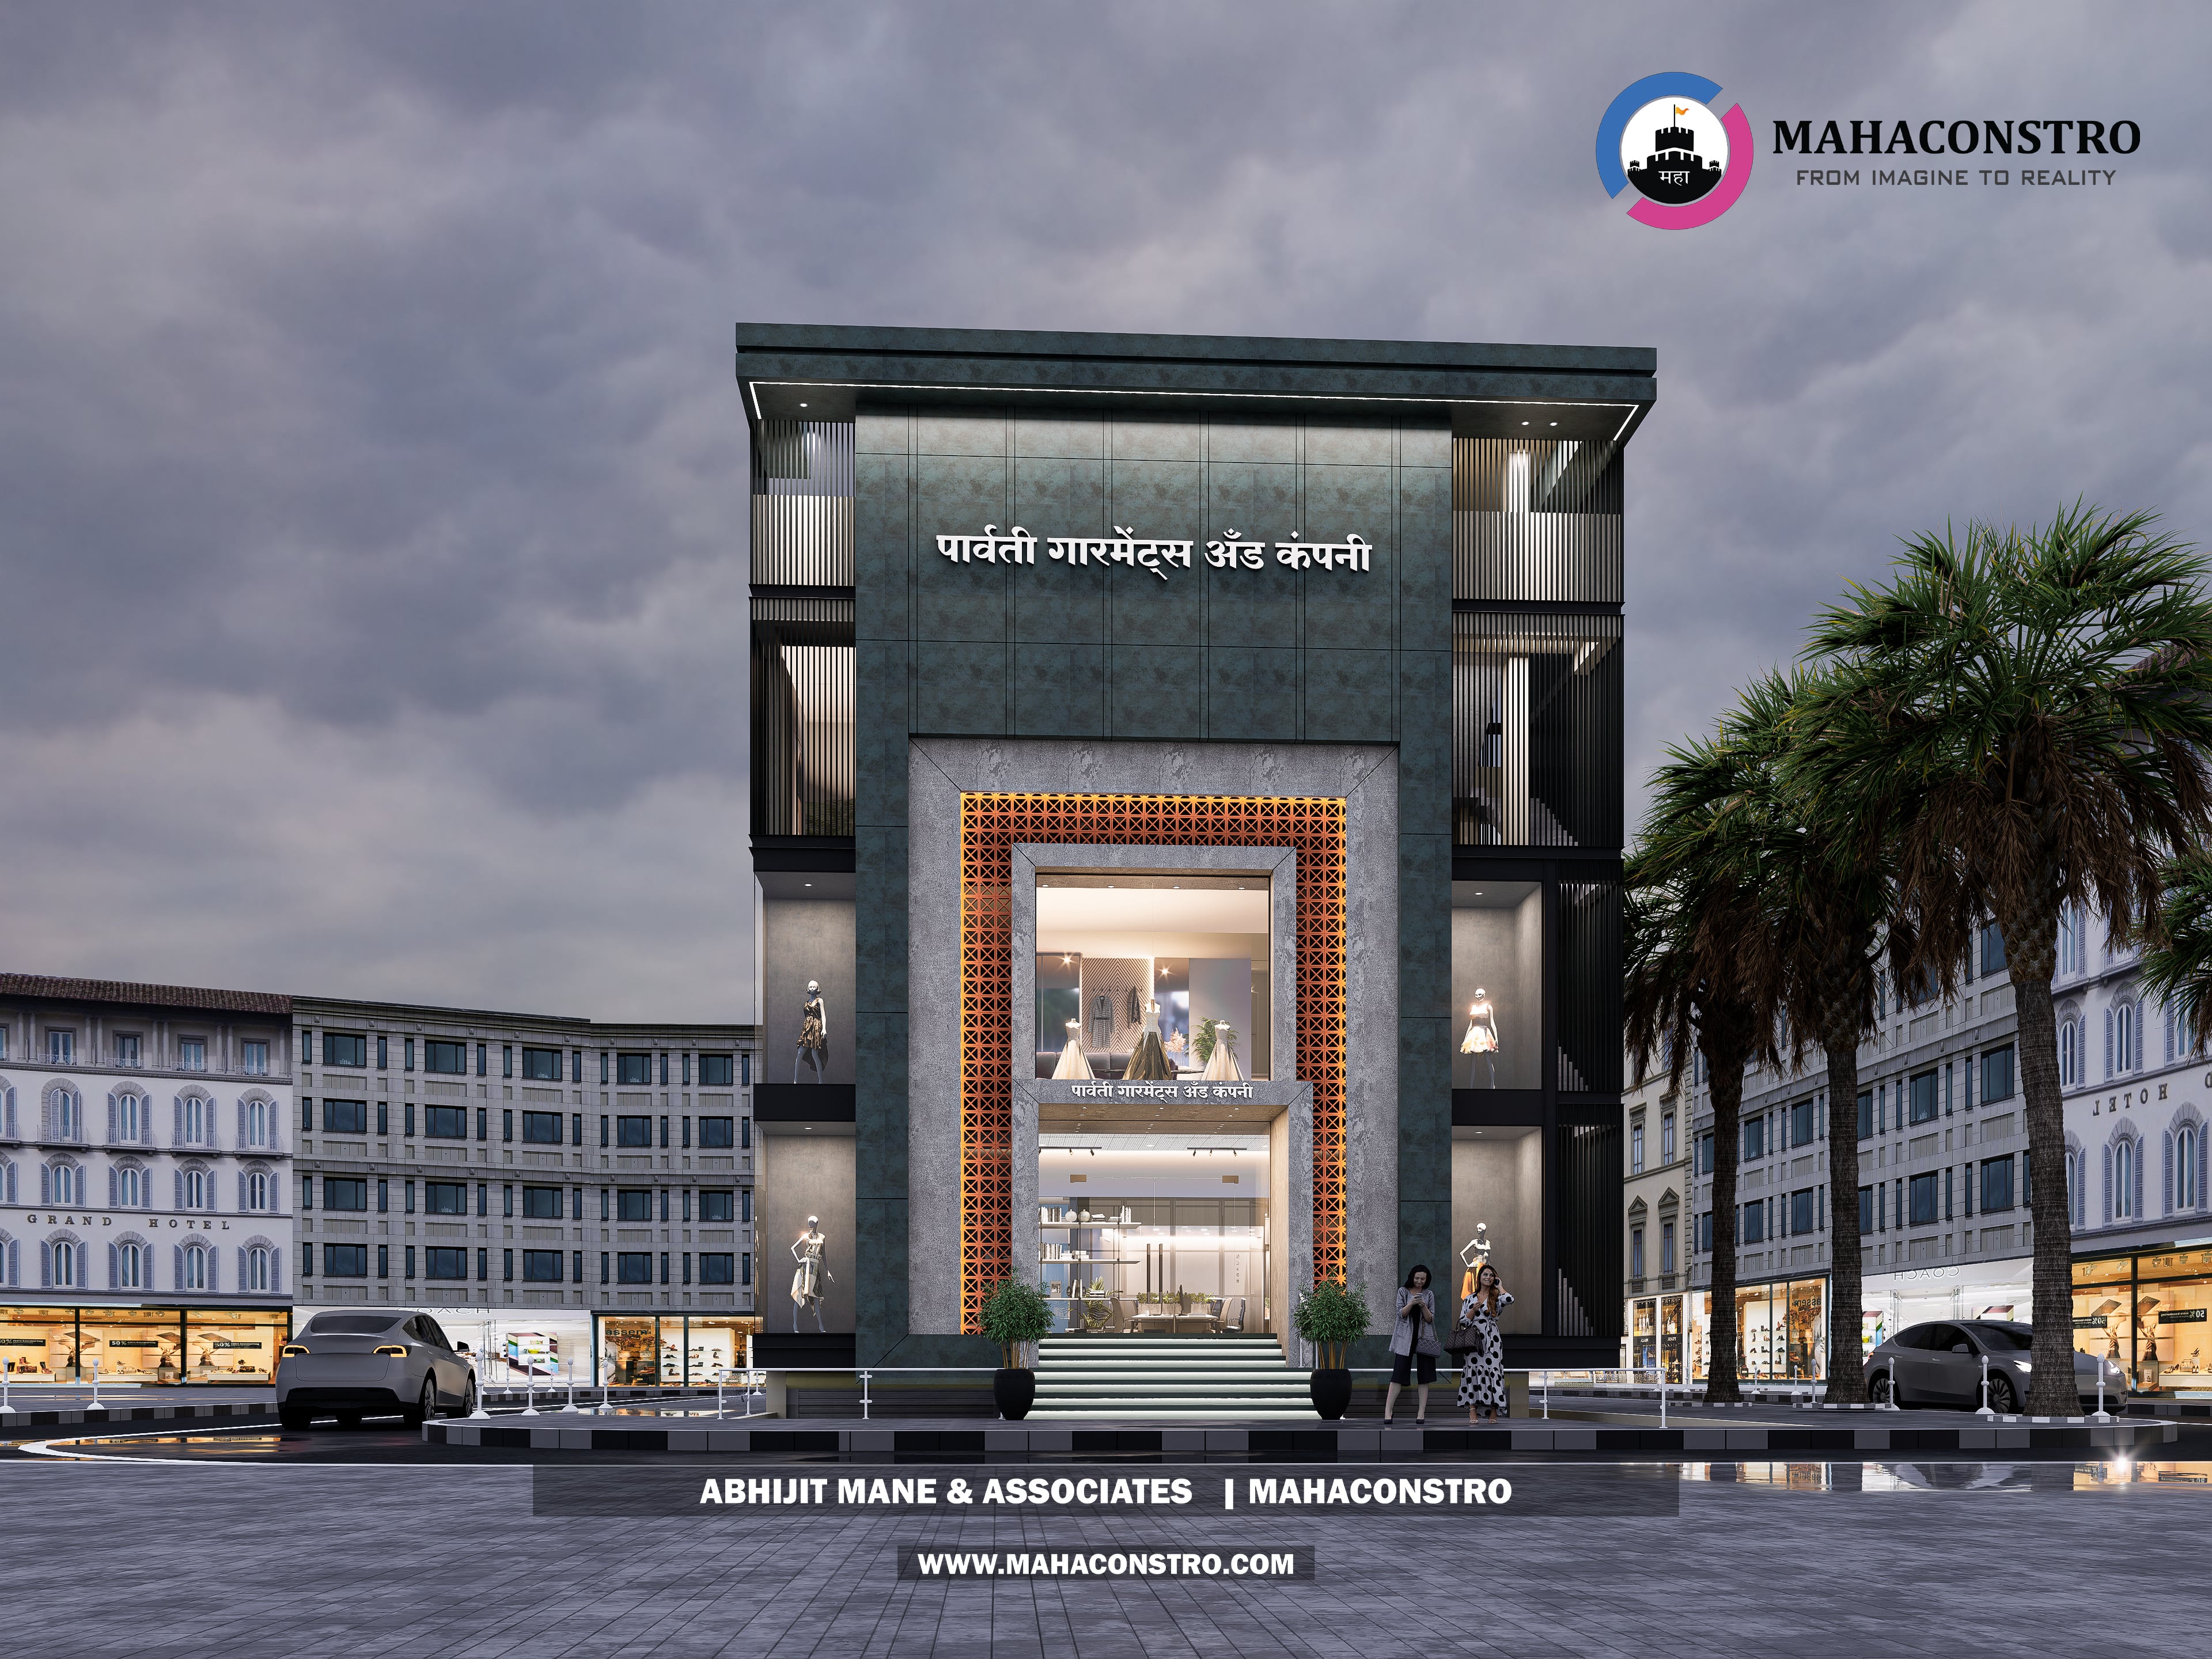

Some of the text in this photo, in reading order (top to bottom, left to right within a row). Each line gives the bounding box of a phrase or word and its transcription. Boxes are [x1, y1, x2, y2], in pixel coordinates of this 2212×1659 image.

[936, 524, 1373, 581] पार्वती गारमेंट्स अँड कंपनी
[1071, 1080, 1254, 1104] पार्वती गारमेंट्स अँड कंपनी
[27, 1214, 230, 1230] GRAND HOTEL
